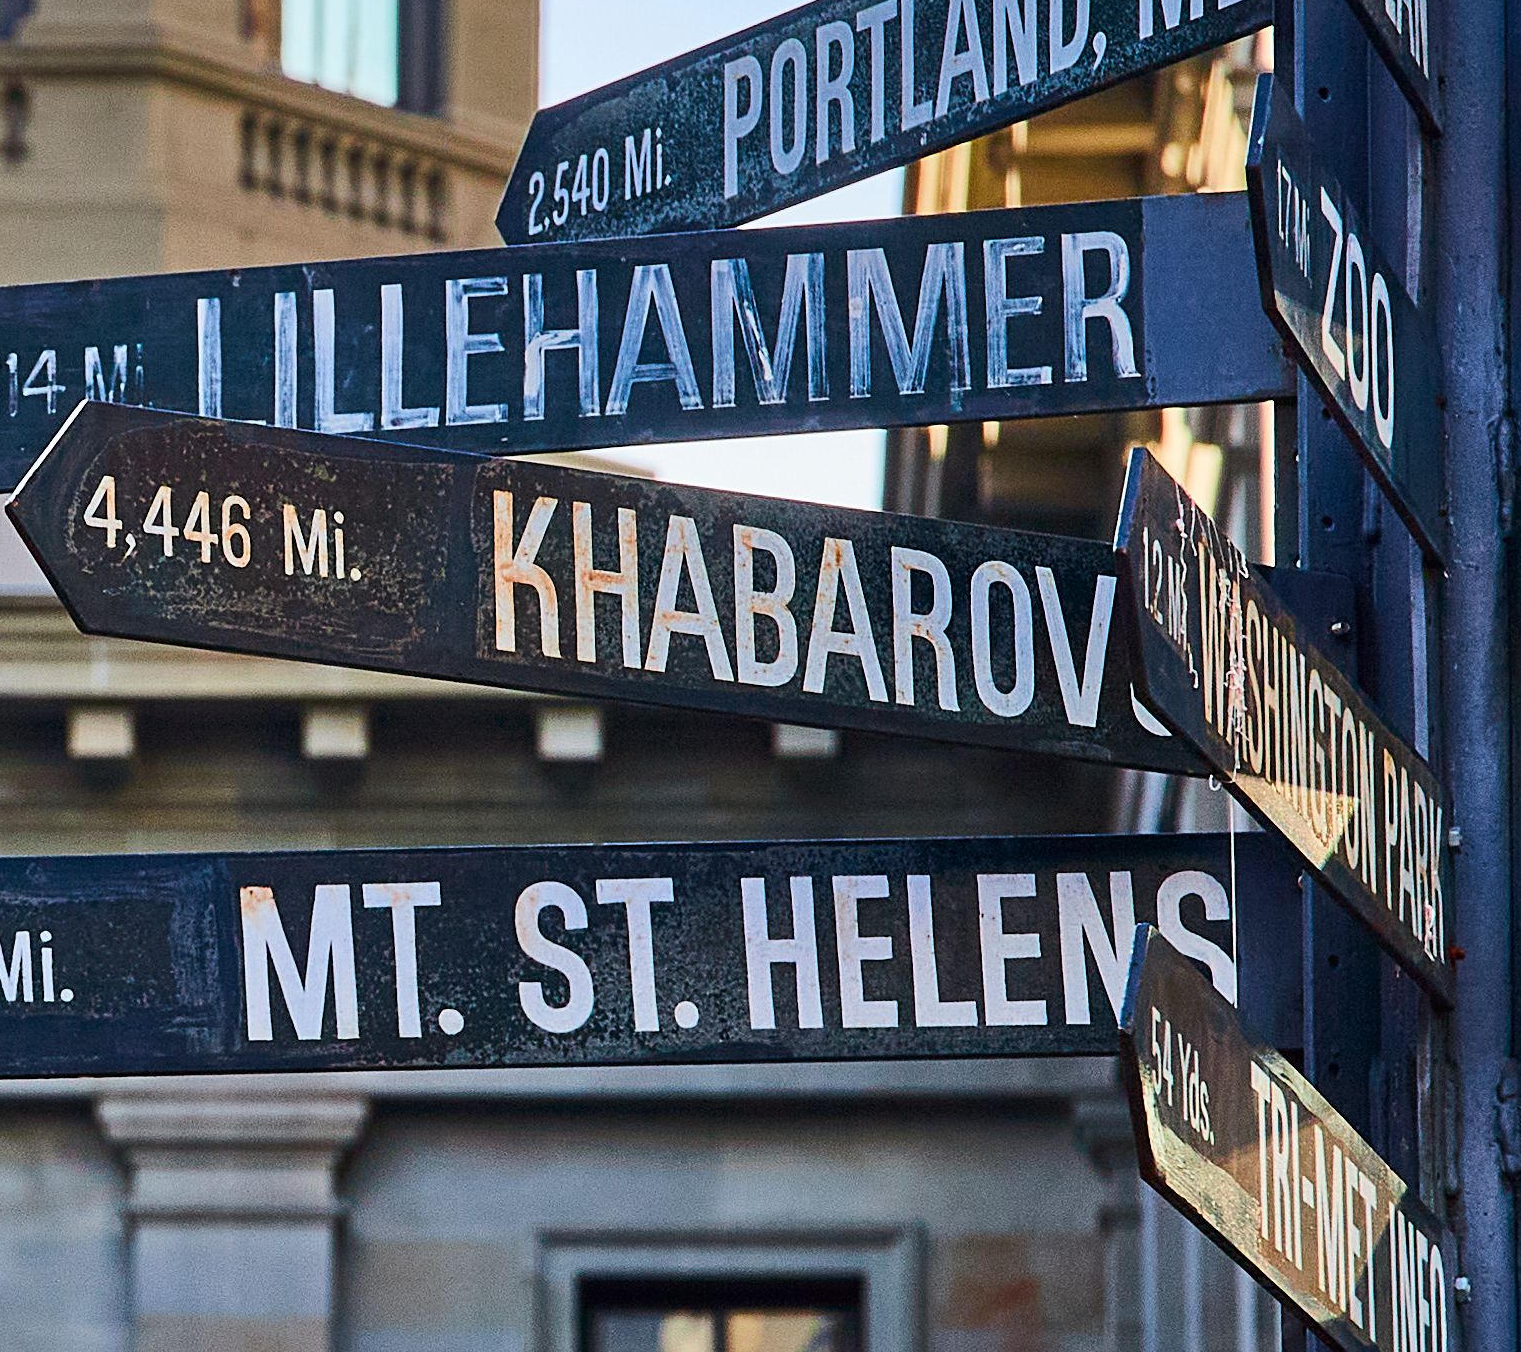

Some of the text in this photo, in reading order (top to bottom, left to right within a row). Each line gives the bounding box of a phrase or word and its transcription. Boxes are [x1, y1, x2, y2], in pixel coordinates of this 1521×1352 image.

[528, 147, 609, 236] 2,540
[624, 127, 672, 201] Mi.
[197, 230, 1142, 434] LILLEHAMMER
[1320, 186, 1394, 450] ZOO
[83, 475, 1172, 737] 4,446 Mi. KHABAROV
[1198, 539, 1377, 895] WASHINGTON
[1383, 747, 1445, 965] PARK
[240, 880, 464, 1043] MT.
[516, 877, 700, 1034] ST.
[741, 868, 1237, 1032] HELENS
[1152, 1006, 1174, 1107] 54
[1178, 1033, 1215, 1146] Yds.
[1251, 1060, 1378, 1343] TRI-MET
